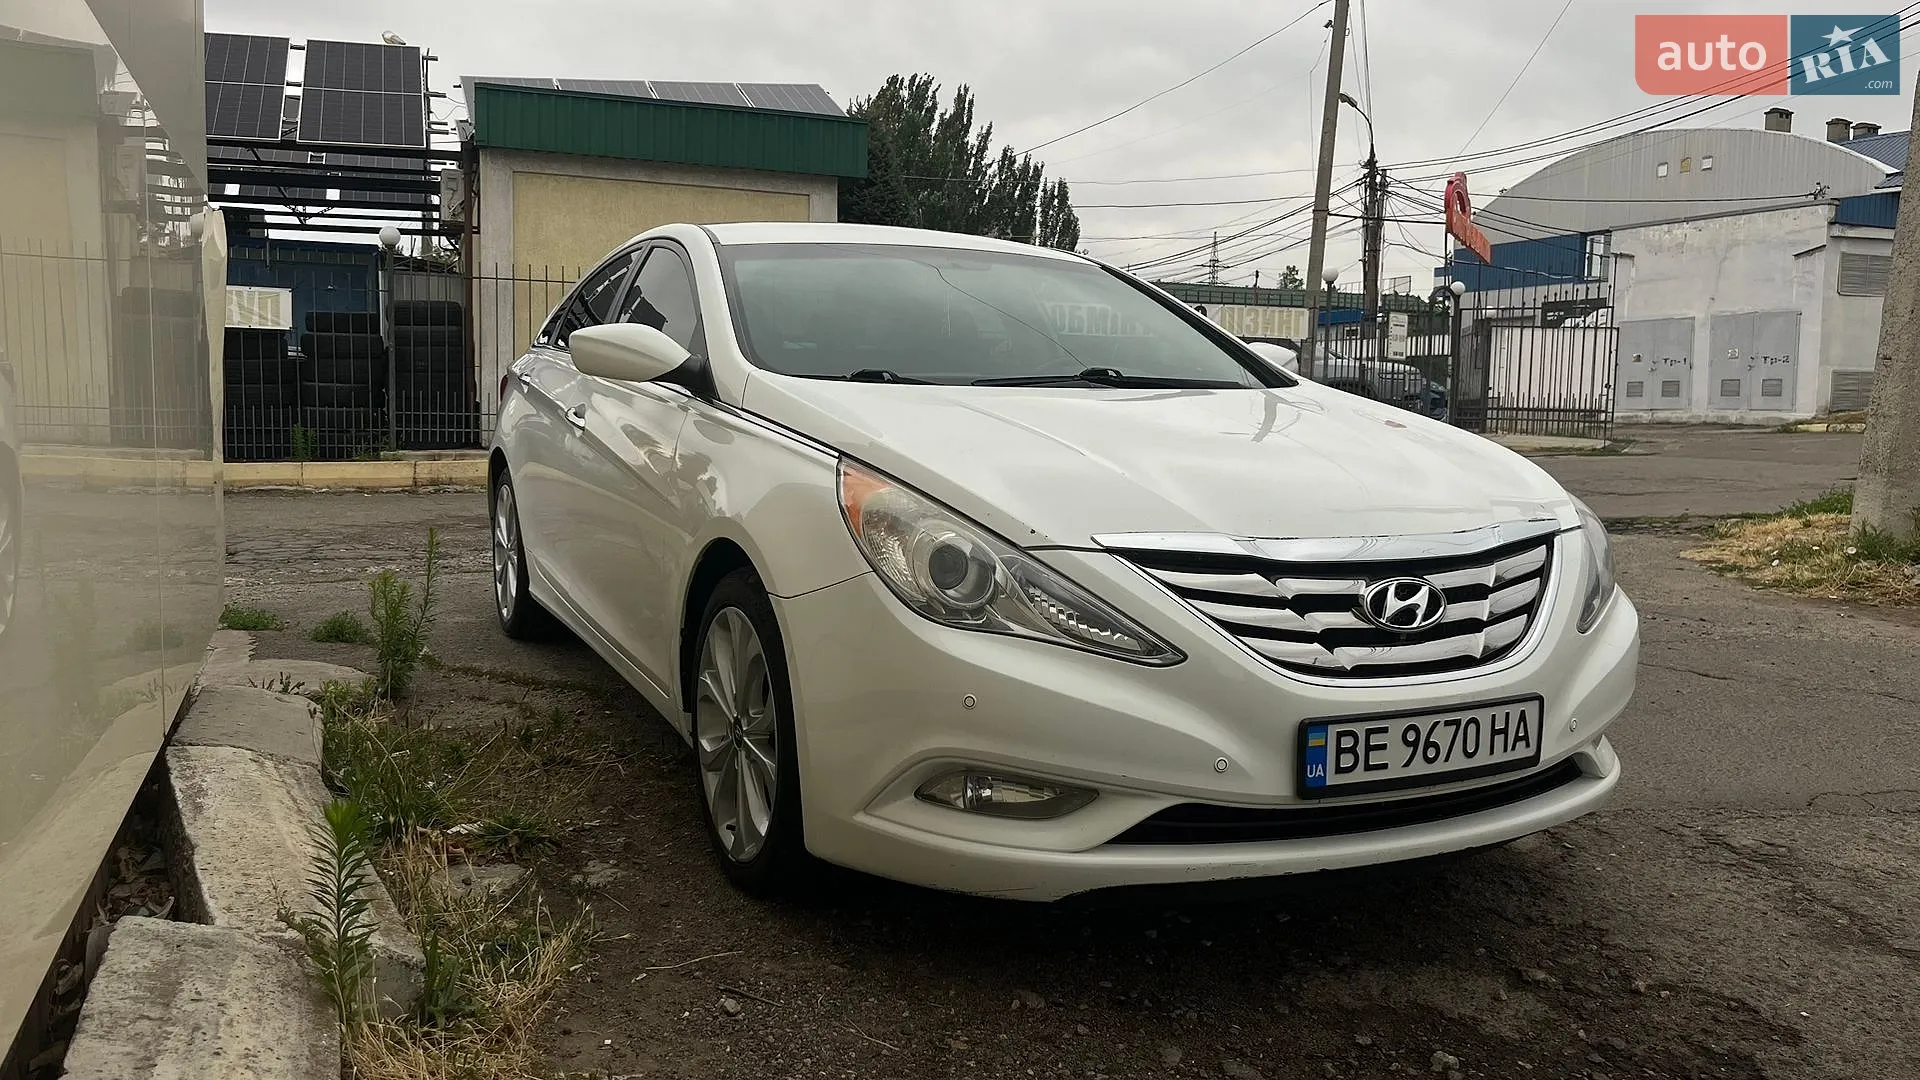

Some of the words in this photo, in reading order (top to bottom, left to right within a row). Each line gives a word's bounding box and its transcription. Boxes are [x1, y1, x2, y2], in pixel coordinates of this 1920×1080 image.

[1334, 726, 1390, 775] BE
[1401, 716, 1481, 768] 9670
[1489, 708, 1531, 756] HA
[1306, 763, 1325, 778] UA
